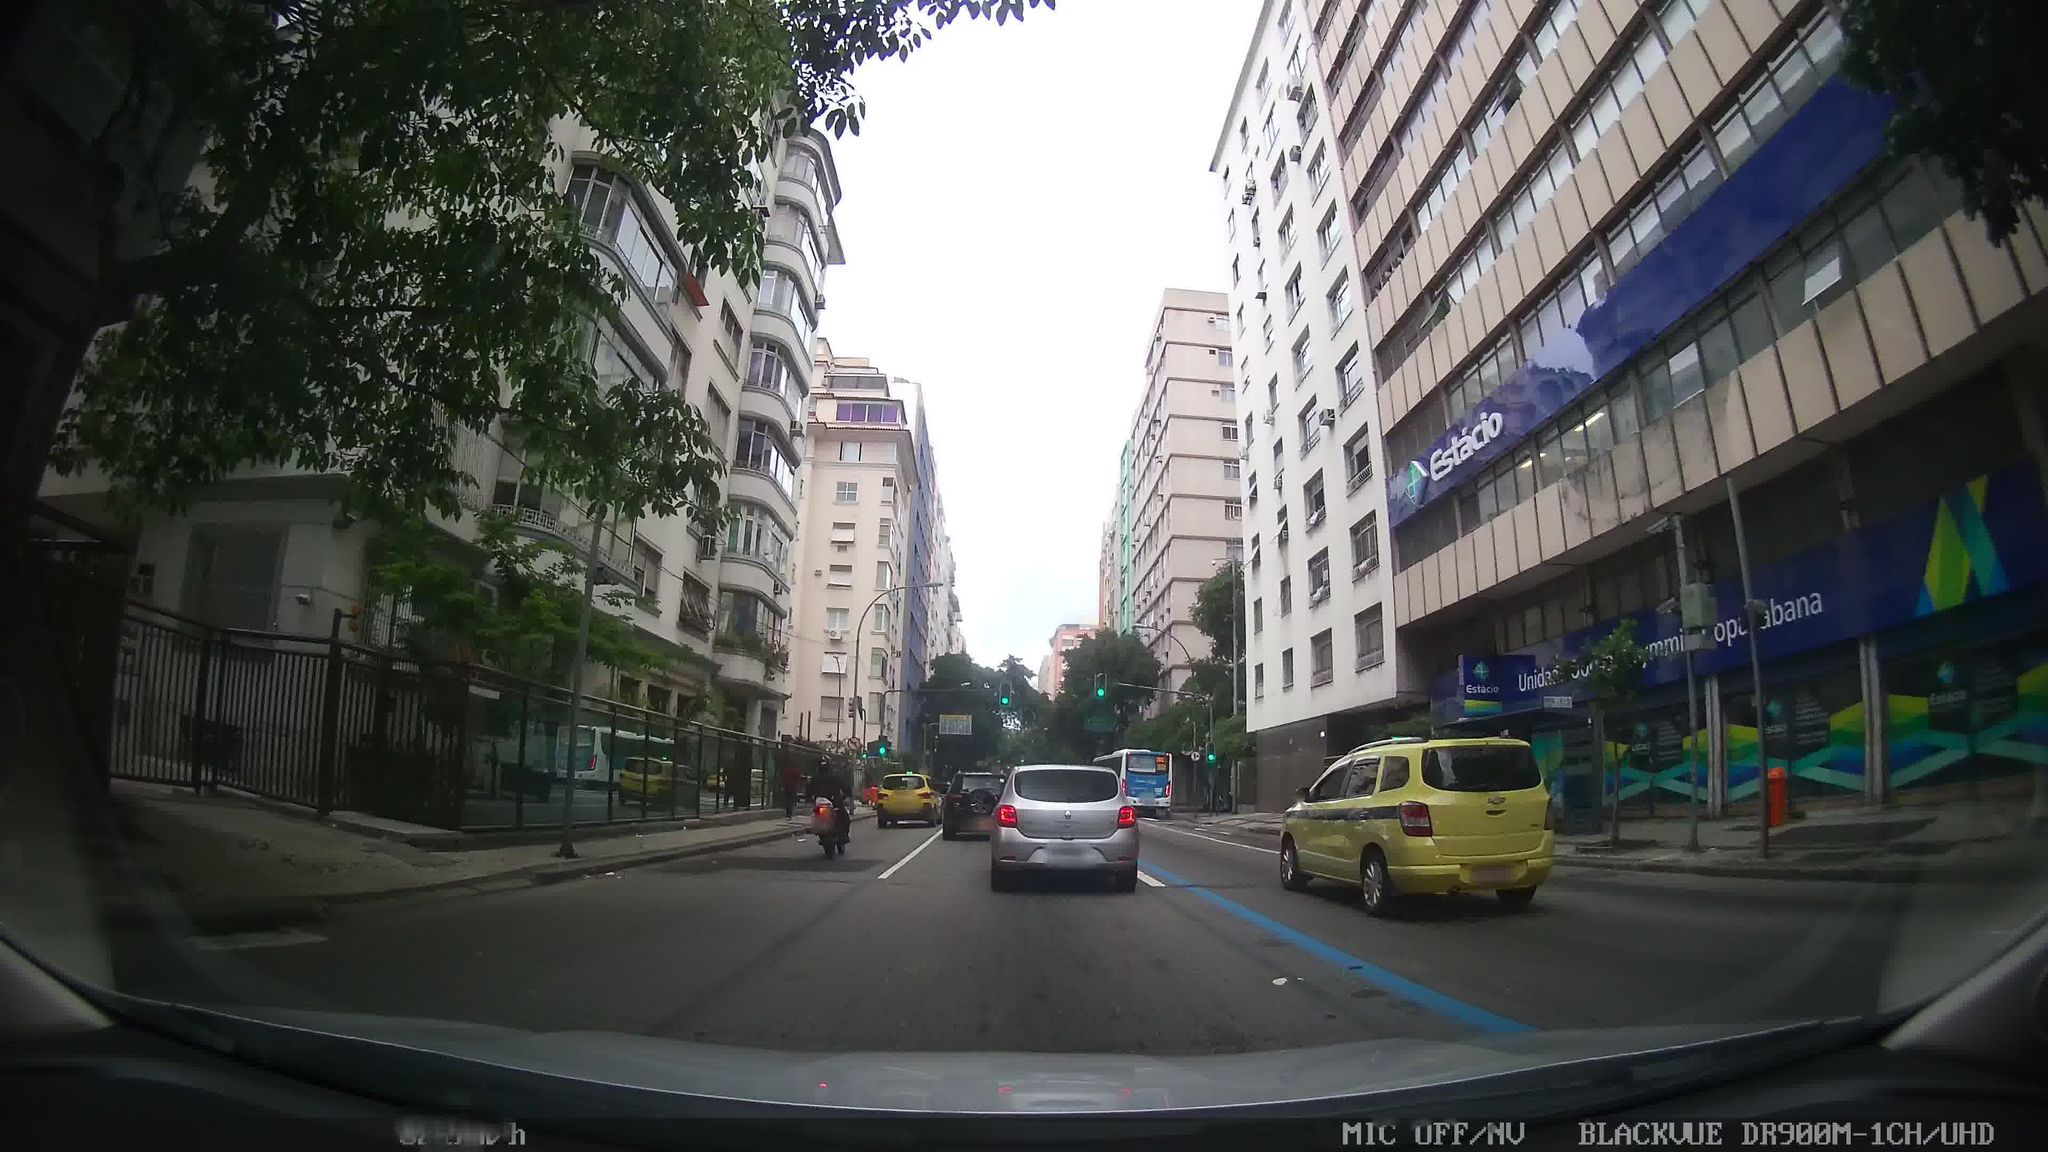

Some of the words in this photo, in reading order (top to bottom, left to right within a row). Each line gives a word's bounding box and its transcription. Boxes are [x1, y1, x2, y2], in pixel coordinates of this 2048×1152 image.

[1430, 412, 1503, 481] Estácio
[1518, 663, 1565, 692] Unida
[1702, 592, 1823, 647] opabana
